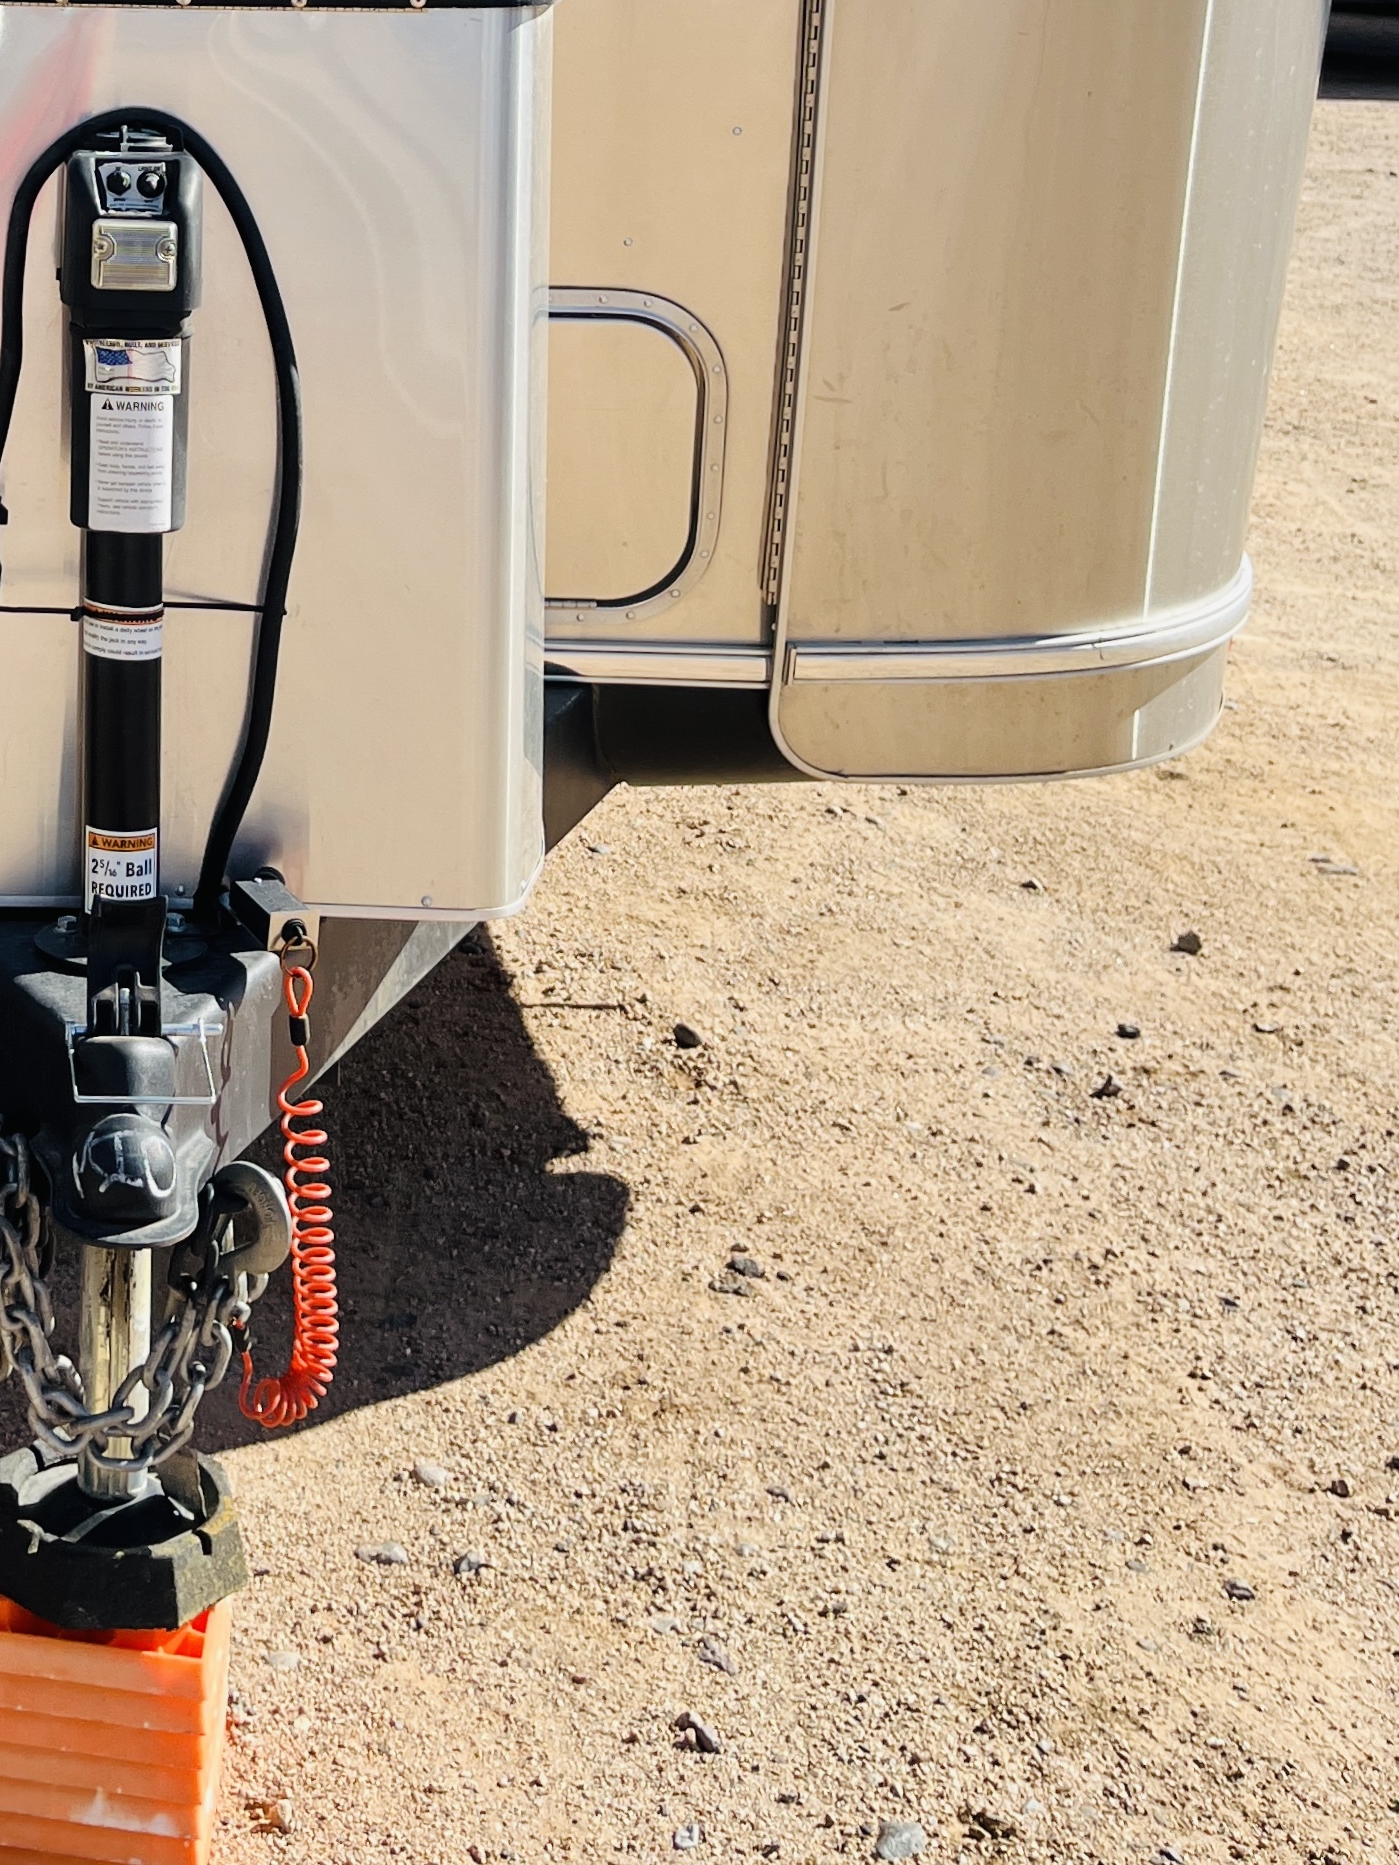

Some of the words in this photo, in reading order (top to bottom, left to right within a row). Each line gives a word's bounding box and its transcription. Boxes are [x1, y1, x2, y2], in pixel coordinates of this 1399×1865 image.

[116, 400, 164, 411] WARNING
[102, 837, 152, 848] WARNING
[126, 858, 152, 877] Ball
[91, 881, 152, 898] REQUIRED
